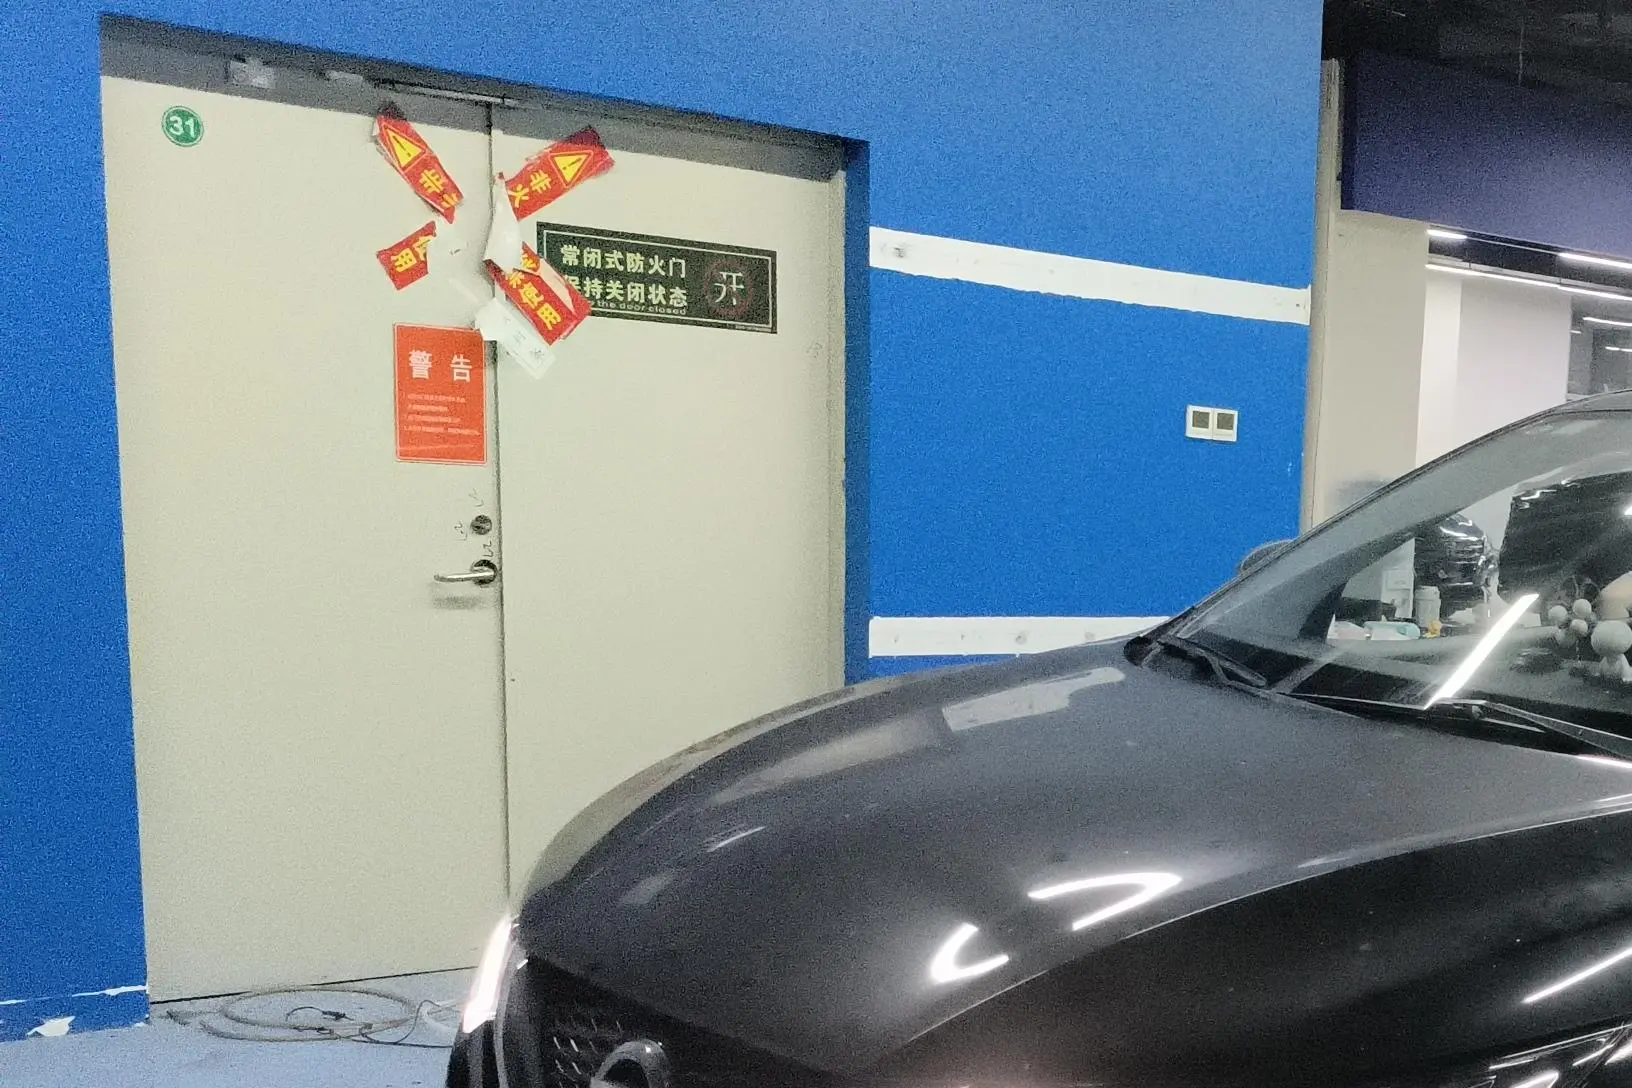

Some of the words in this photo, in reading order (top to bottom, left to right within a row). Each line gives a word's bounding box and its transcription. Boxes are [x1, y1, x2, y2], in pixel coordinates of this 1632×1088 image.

[168, 116, 196, 138] 31
[560, 244, 687, 279] 常闭式防火门
[597, 299, 616, 309] the
[619, 302, 645, 311] door
[648, 306, 687, 315] closed
[408, 350, 473, 383] 警告
